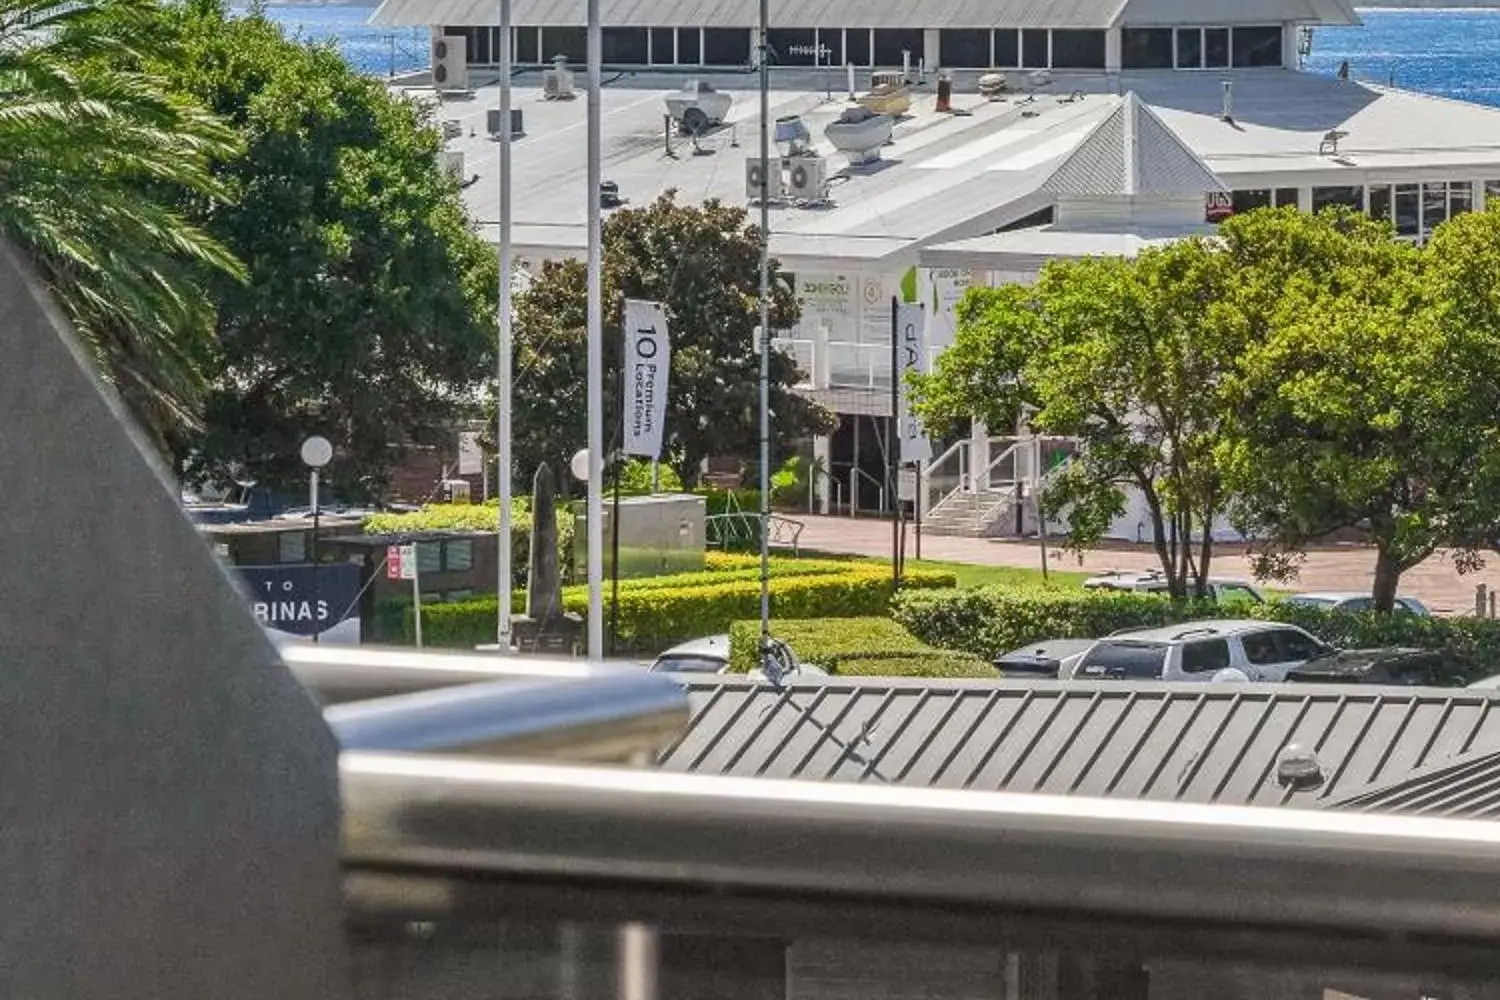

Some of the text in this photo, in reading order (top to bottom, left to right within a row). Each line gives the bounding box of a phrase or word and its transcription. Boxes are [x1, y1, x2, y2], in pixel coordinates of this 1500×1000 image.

[635, 325, 657, 359] 10
[633, 363, 645, 437] Locations
[644, 363, 657, 434] Premium
